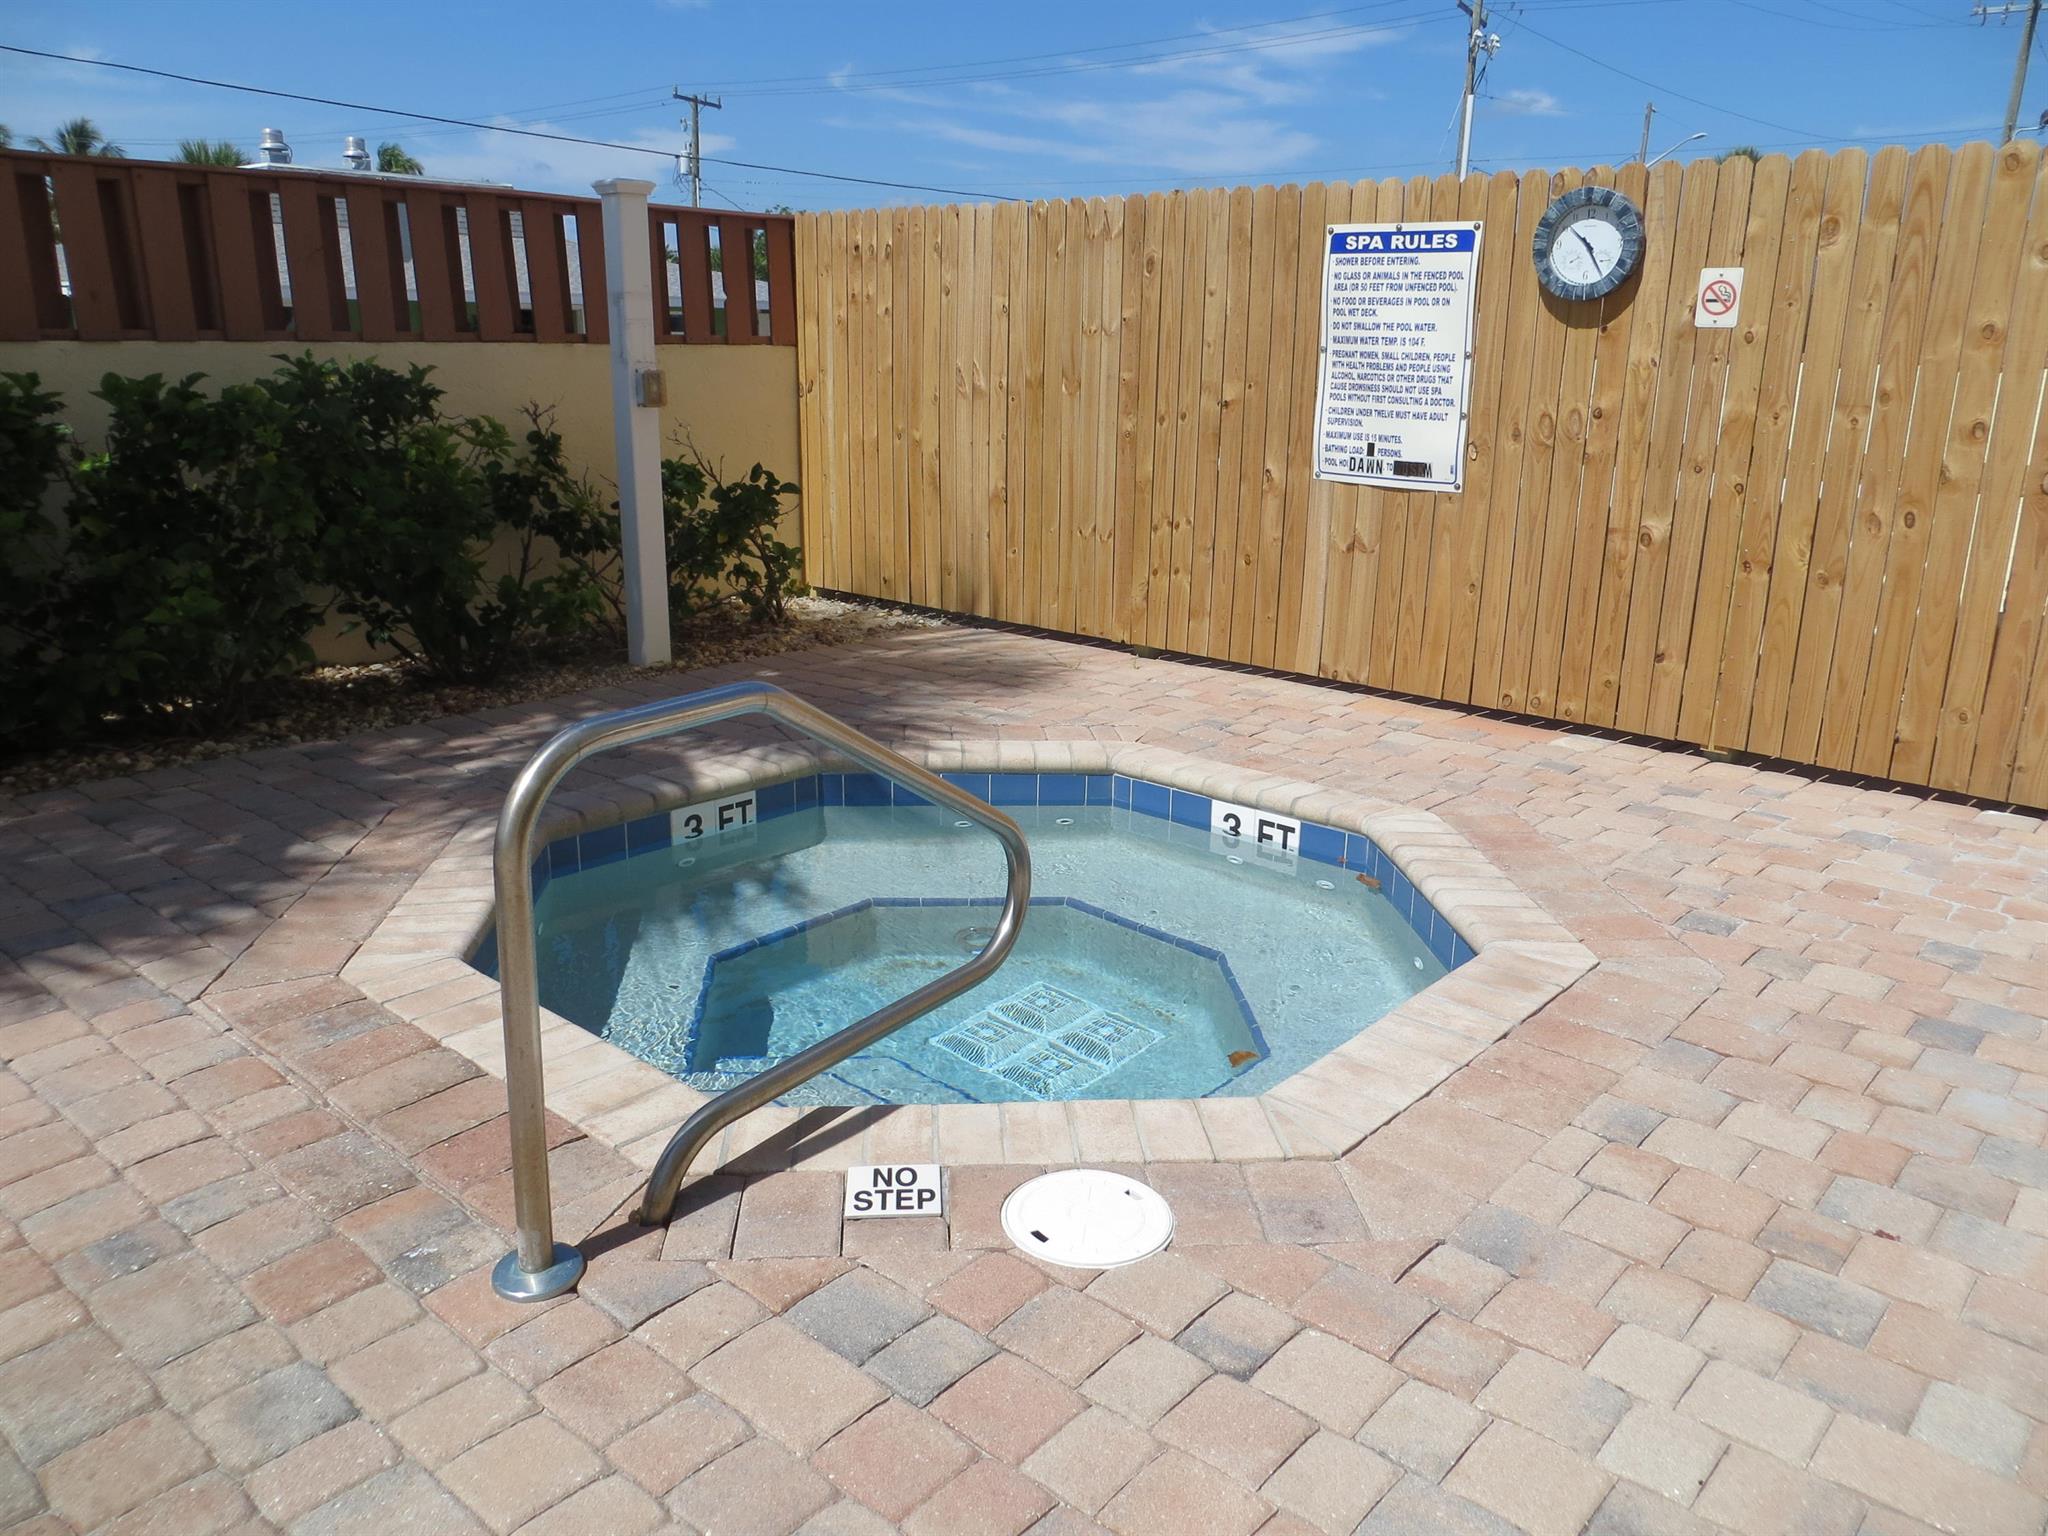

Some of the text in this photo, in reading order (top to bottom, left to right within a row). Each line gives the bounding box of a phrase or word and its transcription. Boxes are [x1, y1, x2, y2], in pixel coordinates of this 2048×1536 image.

[1345, 234, 1458, 249] SPA RULES
[1335, 257, 1420, 265] SHOWER BEFORE ENTERING.
[1334, 272, 1464, 280] NO GLASS OR ANIMALS IN THE FENCED POOL
[1334, 283, 1348, 291] AREA
[1360, 283, 1367, 291] 50
[1369, 283, 1384, 291] FEET
[1386, 283, 1403, 291] FROM
[1405, 283, 1437, 291] UNFENCED
[1368, 298, 1403, 306] BEVERAGES
[1414, 298, 1430, 306] POOL
[1432, 298, 1440, 306] OR
[1442, 298, 1450, 306] ON
[1361, 309, 1378, 317] DECK.
[1342, 322, 1352, 330] NOT
[1354, 322, 1381, 331] SWALLOW
[1383, 323, 1394, 331] THE
[1396, 323, 1412, 331] POOL
[1414, 323, 1437, 332] WATER.
[1333, 336, 1358, 344] MAXIMUM
[1360, 336, 1379, 345] WATER
[1381, 337, 1398, 346] TEMP.
[1332, 350, 1358, 358] PREGNANT
[1381, 352, 1399, 360] SMALL
[1434, 353, 1456, 362] PEOPLE
[1346, 361, 1365, 369] HEALTH
[1366, 362, 1394, 371] PROBLEMS
[1396, 363, 1407, 371] AND
[1409, 364, 1431, 372] PEOPLE
[1432, 365, 1450, 373] USING
[1357, 373, 1385, 382] NARCOTICS
[1387, 374, 1394, 382] OR
[1417, 375, 1436, 384] DRUGS
[1438, 376, 1453, 384] THAT
[1348, 383, 1380, 392] DROWSINESS
[1382, 385, 1403, 393] SHOULD
[1405, 386, 1417, 394] NOT
[1431, 387, 1442, 395] SPA
[1348, 394, 1371, 402] WITHOUT
[1372, 395, 1386, 403] FIRST
[1387, 396, 1423, 405] CONSULTING
[1430, 398, 1455, 407] DOCTOR.
[1328, 407, 1354, 415] CHILDREN
[1356, 408, 1372, 416] UNDER
[1374, 410, 1394, 418] TWELVE
[1412, 412, 1428, 420] HAVE
[1326, 431, 1351, 440] MAXIMUM
[1353, 432, 1363, 440] USE
[1371, 434, 1377, 442] 15
[1378, 434, 1402, 444] MINUTES.
[1325, 444, 1348, 453] BATHING
[1325, 458, 1337, 466] POOL
[1349, 457, 1383, 474] DAWN
[1386, 463, 1393, 471] TO
[684, 814, 703, 838] 3
[1222, 813, 1241, 836] 3
[873, 1167, 918, 1187] NO
[853, 1189, 936, 1211] STEP
